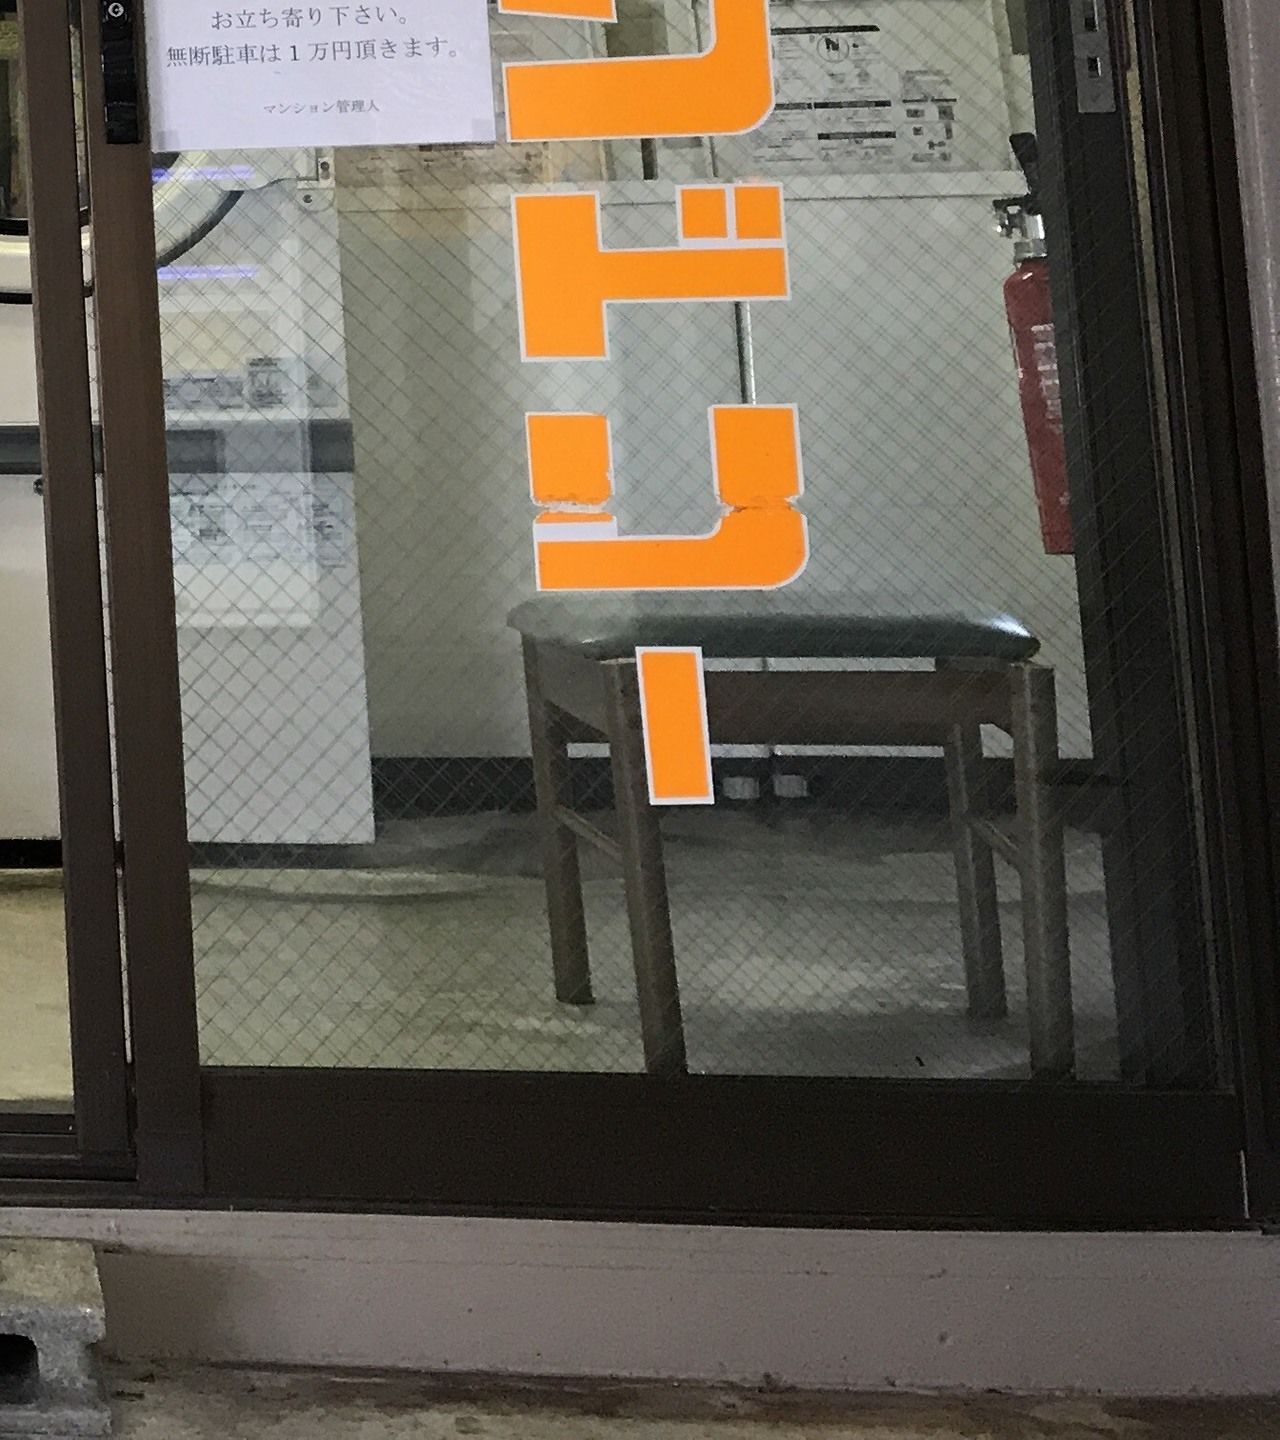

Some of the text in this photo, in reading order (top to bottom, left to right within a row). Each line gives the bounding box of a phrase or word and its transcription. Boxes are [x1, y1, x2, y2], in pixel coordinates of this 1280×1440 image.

[211, 5, 409, 31] お立ち寄り下さい。
[263, 99, 380, 115] マンション管理人
